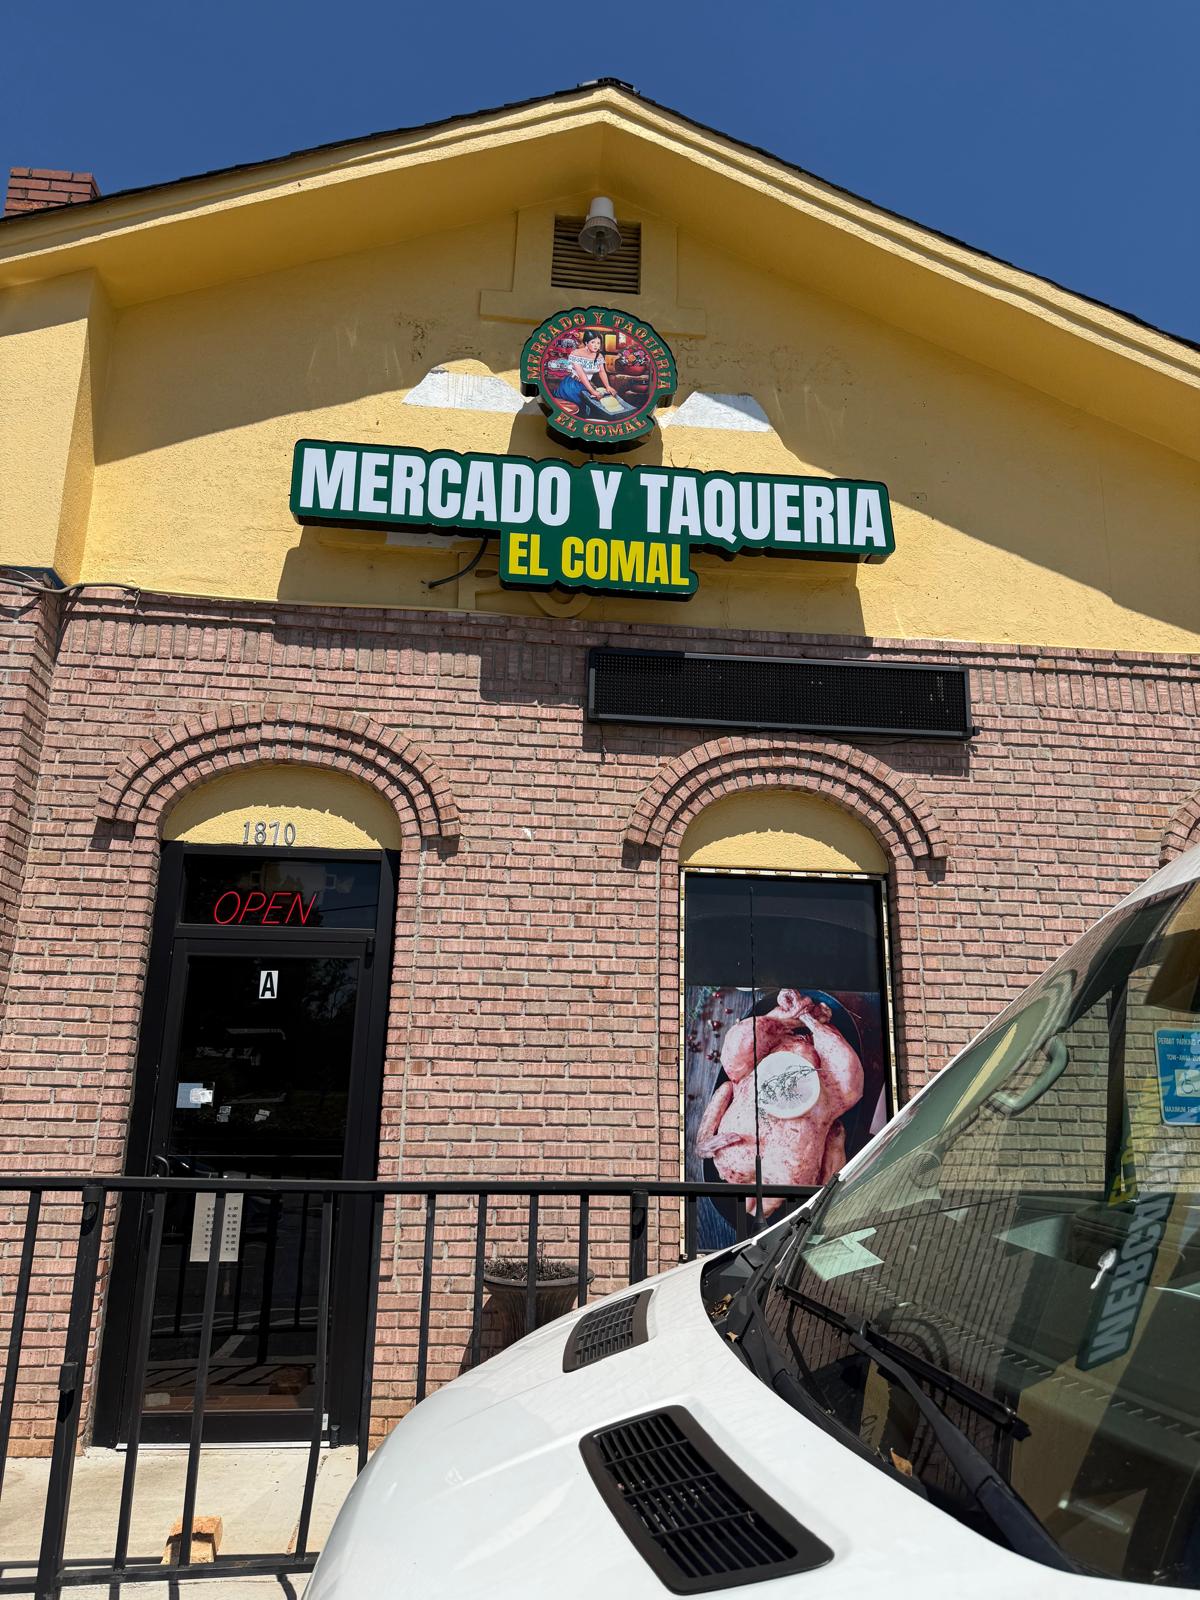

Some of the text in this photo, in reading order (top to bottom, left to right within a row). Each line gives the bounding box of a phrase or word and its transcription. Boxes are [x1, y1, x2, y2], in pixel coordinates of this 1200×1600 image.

[527, 312, 671, 389] MERCADO Y TAQUERIA
[554, 412, 647, 437] EL COMAL
[299, 447, 887, 547] MERCADO Y TAQUERIA
[508, 532, 690, 586] EL COMAL
[243, 821, 296, 847] 1870
[214, 890, 317, 925] OPEN
[260, 971, 276, 998] A
